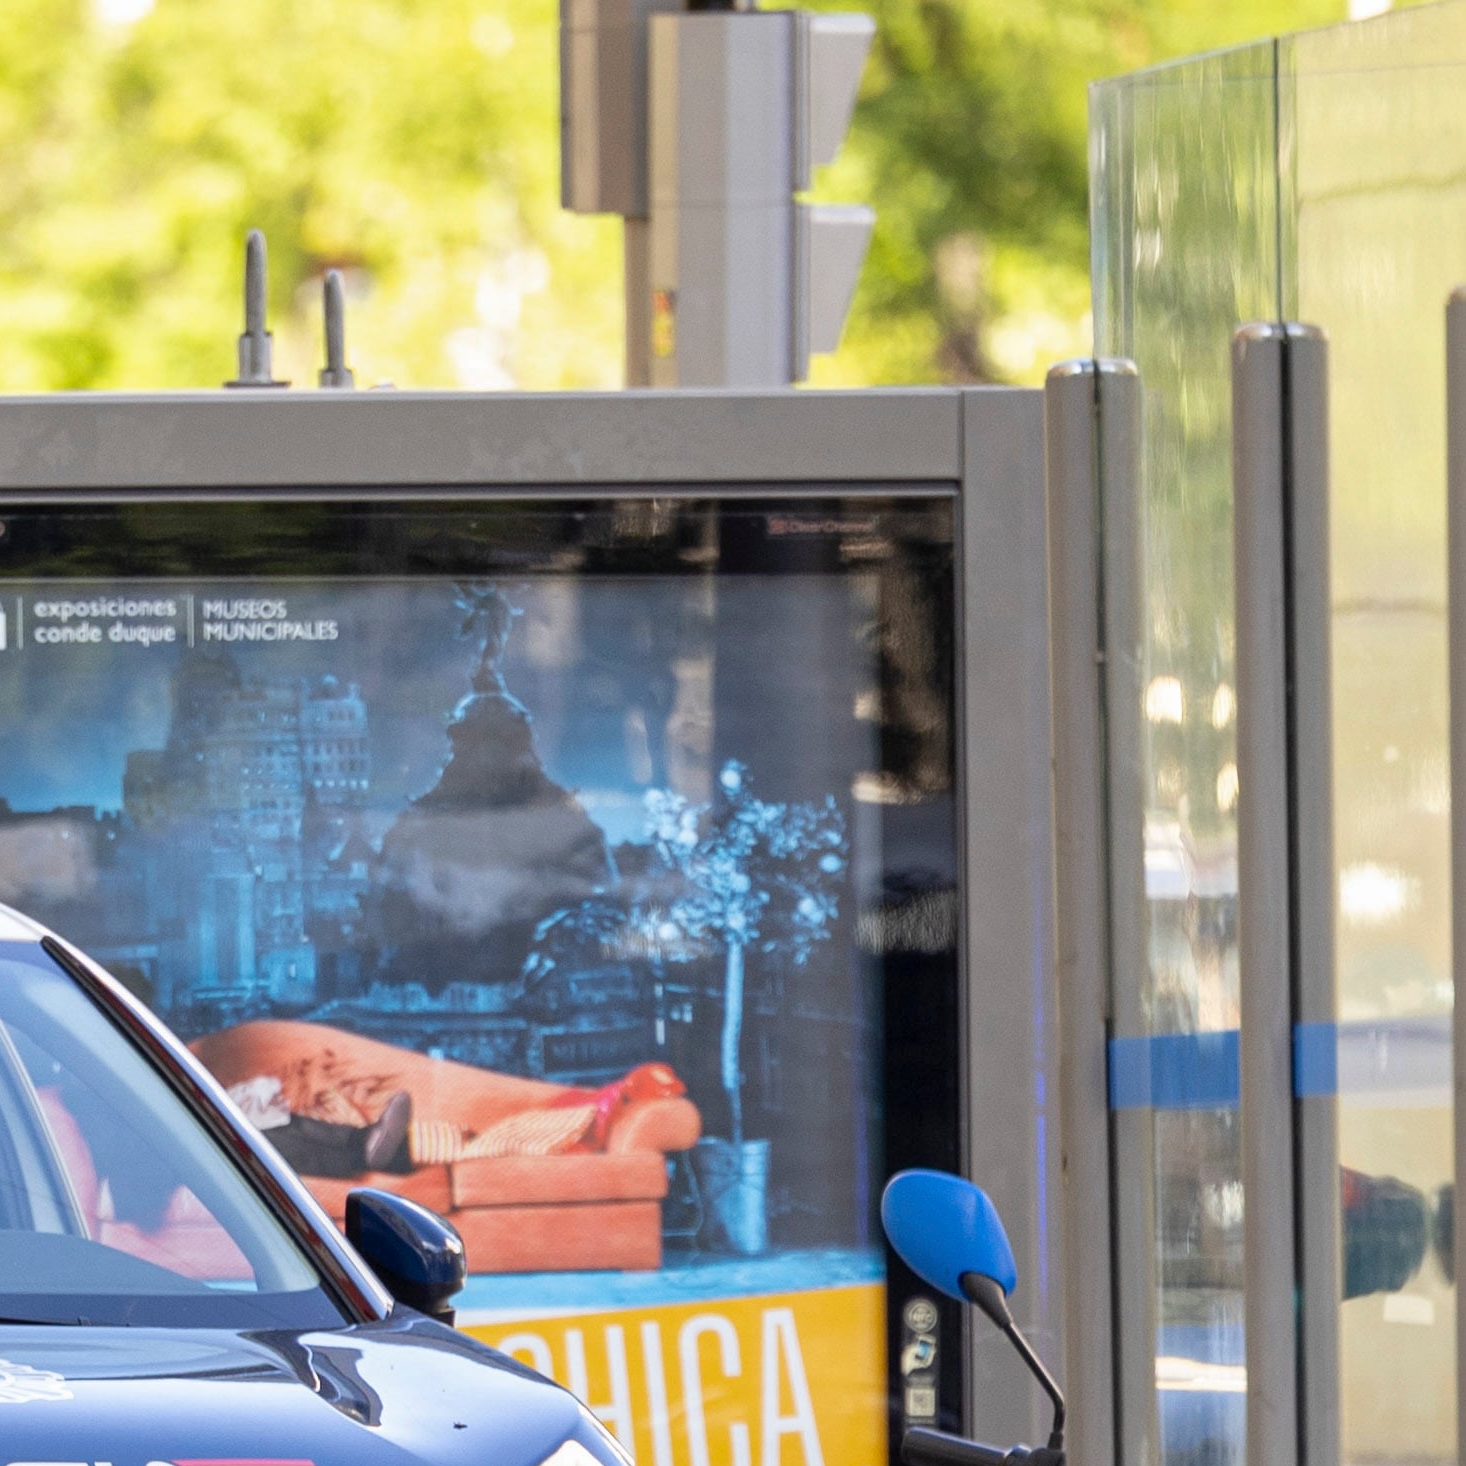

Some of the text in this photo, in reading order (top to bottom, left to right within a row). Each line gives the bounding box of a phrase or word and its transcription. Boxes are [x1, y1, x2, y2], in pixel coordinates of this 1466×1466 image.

[33, 597, 177, 623] exposiciones
[202, 600, 287, 619] MUSEOS
[34, 620, 176, 647] conde duque
[202, 620, 338, 641] MUNICIPALES
